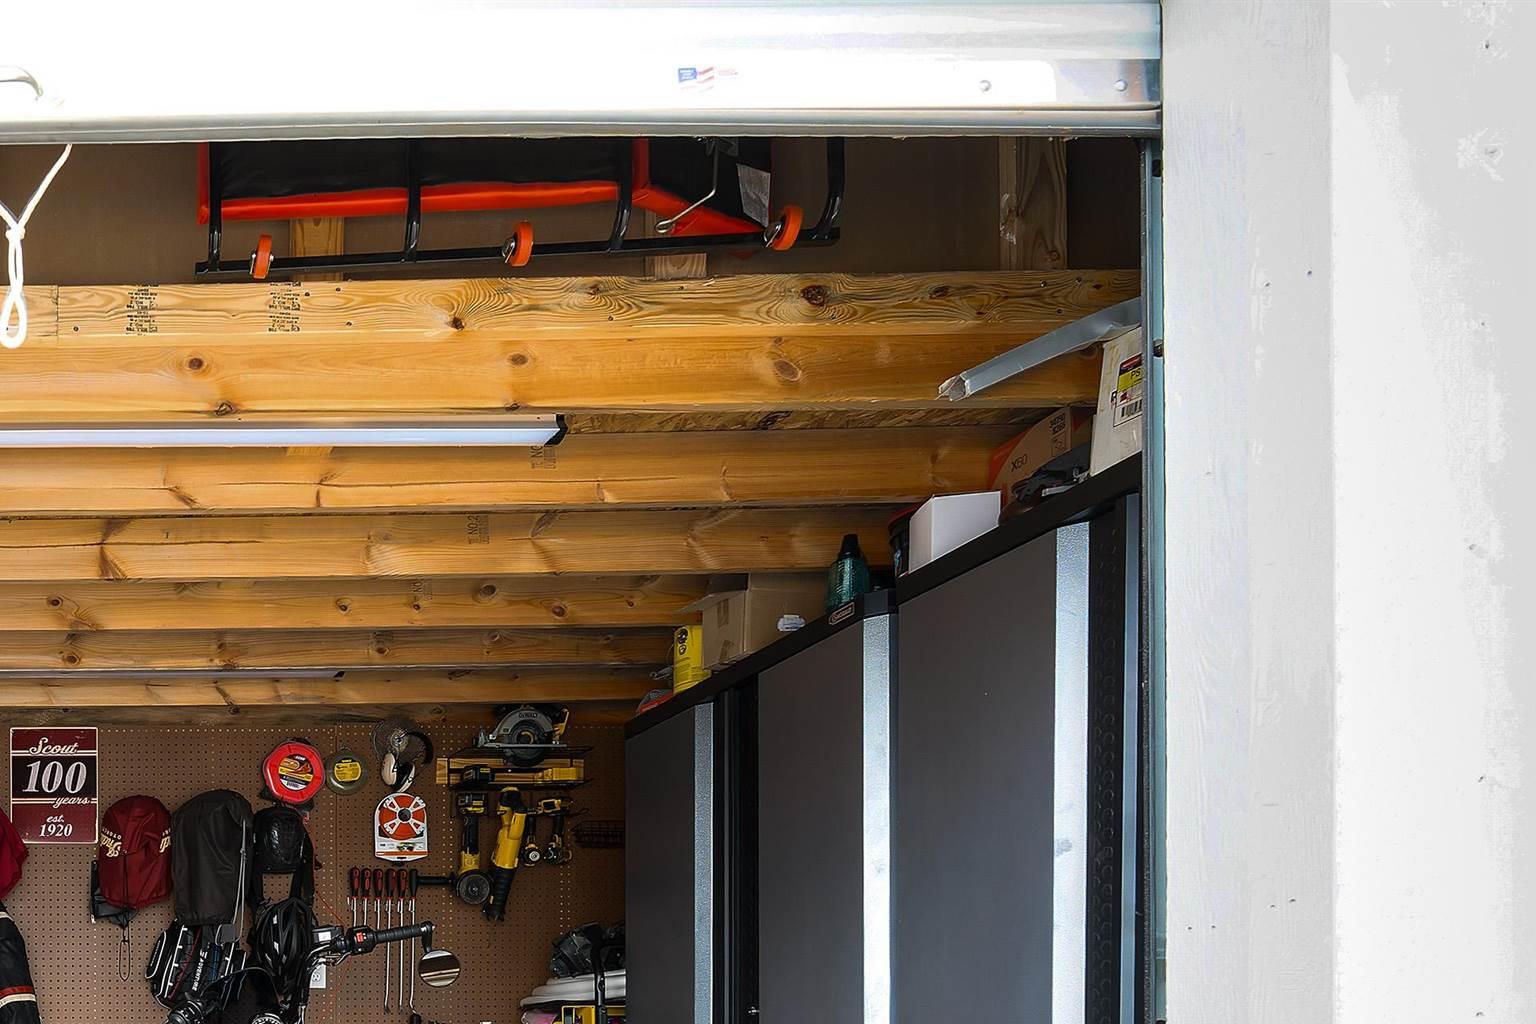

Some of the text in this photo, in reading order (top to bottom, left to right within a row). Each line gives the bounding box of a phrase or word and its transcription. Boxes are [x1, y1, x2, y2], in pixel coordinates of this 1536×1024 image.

[29, 737, 79, 754] Scout
[22, 761, 87, 793] 100
[52, 796, 90, 809] years
[46, 814, 65, 823] est.
[39, 823, 73, 837] 1920
